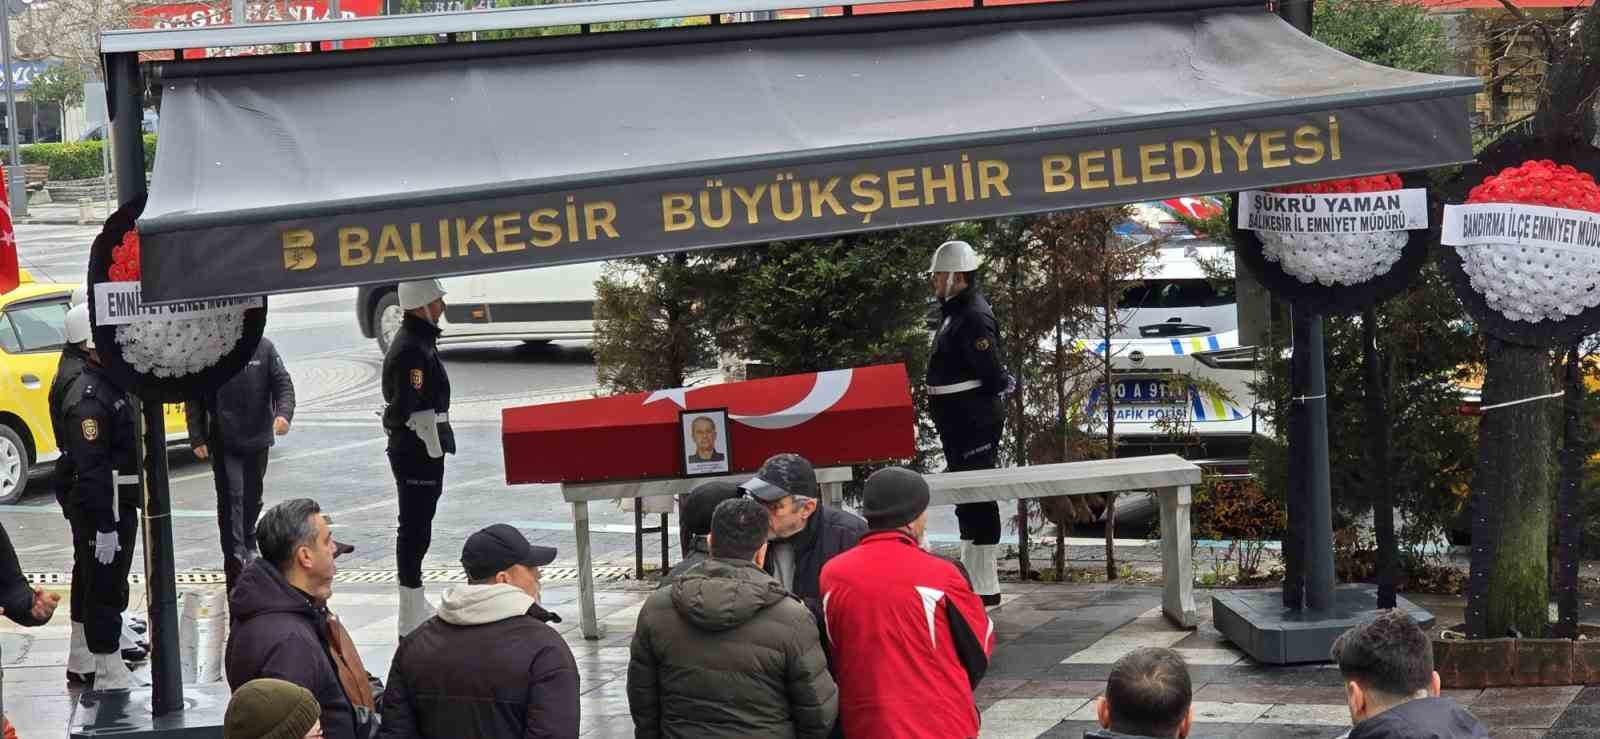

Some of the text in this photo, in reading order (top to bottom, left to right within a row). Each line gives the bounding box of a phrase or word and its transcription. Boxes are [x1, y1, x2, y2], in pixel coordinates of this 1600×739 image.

[337, 195, 621, 268] BALIKESİR
[661, 152, 1013, 233] BÜYÜKŞEHİR
[1040, 113, 1342, 193] BELEDİYESİ
[1253, 194, 1401, 214] ŞÜKRÜ YAMAN
[1248, 212, 1291, 232] BALIKESİR
[1294, 212, 1304, 232] İL
[1307, 213, 1357, 233] EMNİYET
[1360, 210, 1406, 232] MÜDÜRÜ
[1463, 212, 1505, 239] BANDIRMA
[1507, 207, 1531, 243] İLÇE
[1531, 210, 1577, 244] EMNİYET
[1133, 383, 1142, 398] A
